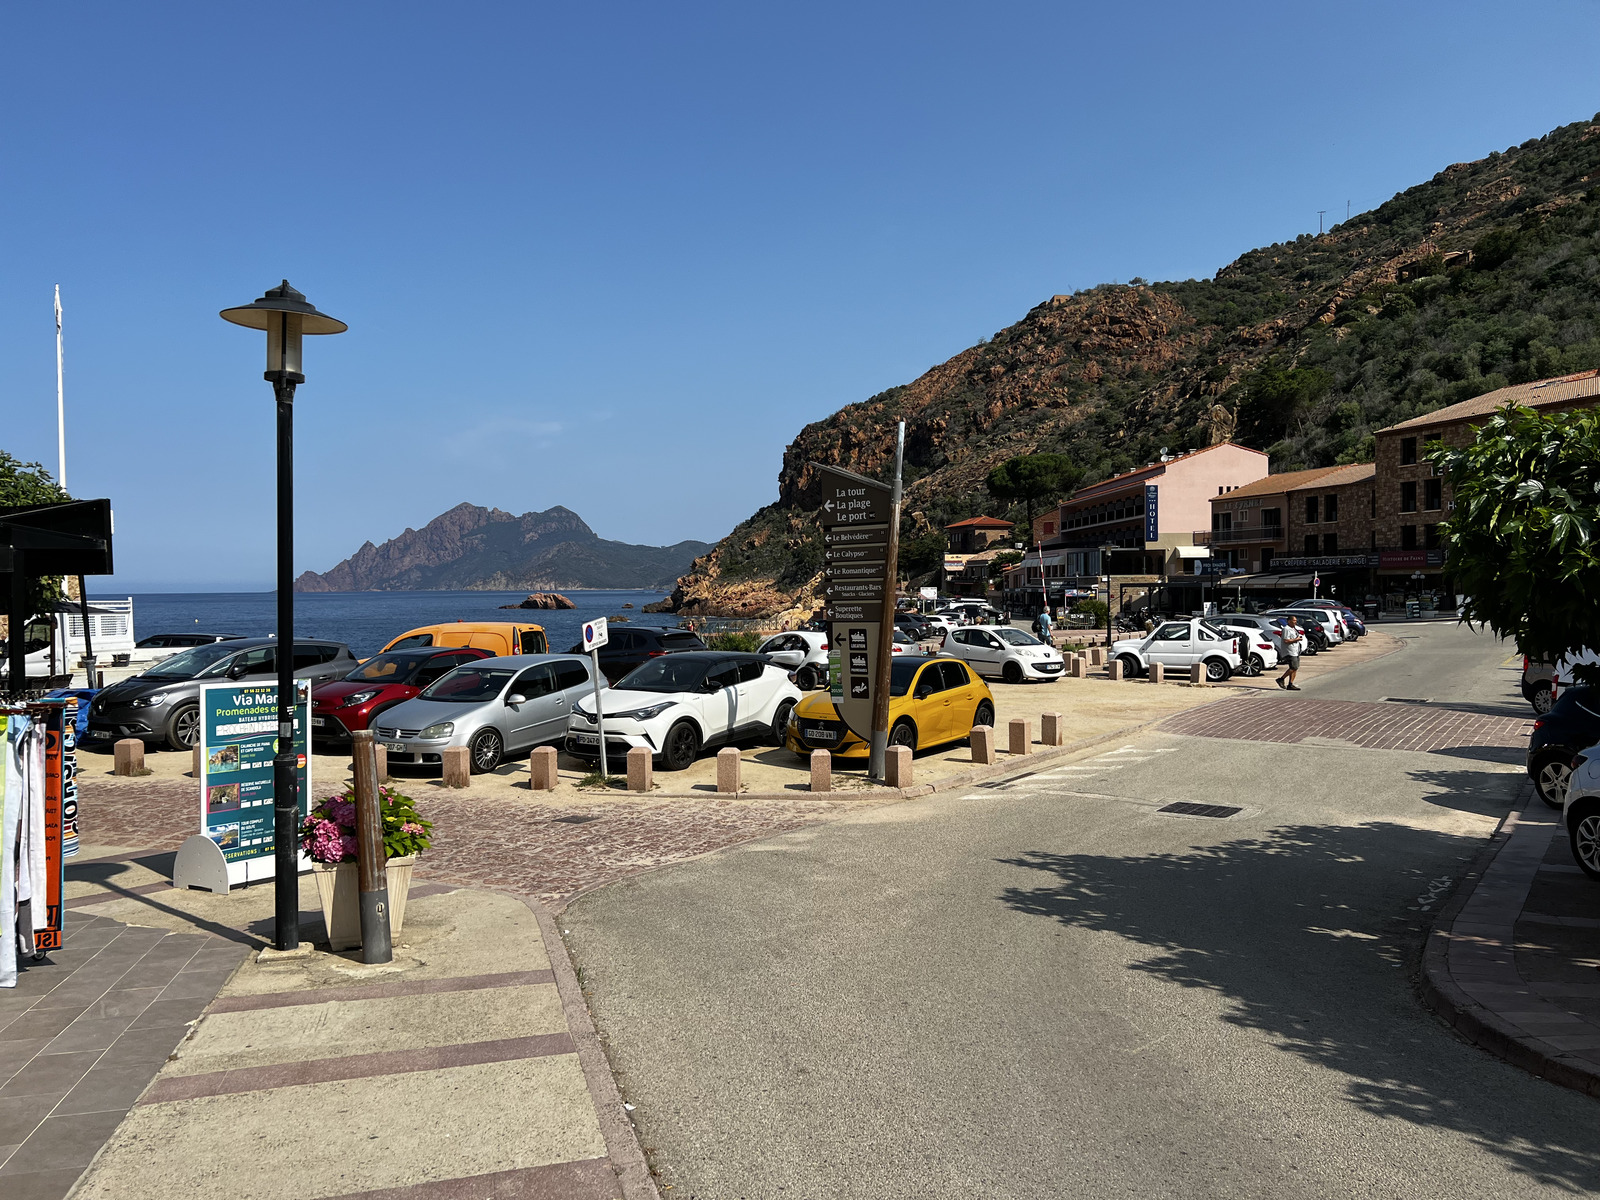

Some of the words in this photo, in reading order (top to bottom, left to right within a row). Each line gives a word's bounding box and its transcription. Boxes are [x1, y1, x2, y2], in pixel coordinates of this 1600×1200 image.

[836, 488, 846, 497] La
[848, 488, 865, 496] tour
[836, 501, 846, 509] La
[848, 499, 870, 510] plage
[837, 513, 846, 521] Le
[848, 512, 866, 522] port
[232, 694, 253, 706] Via
[255, 694, 278, 704] Mar
[216, 706, 269, 716] Promenades
